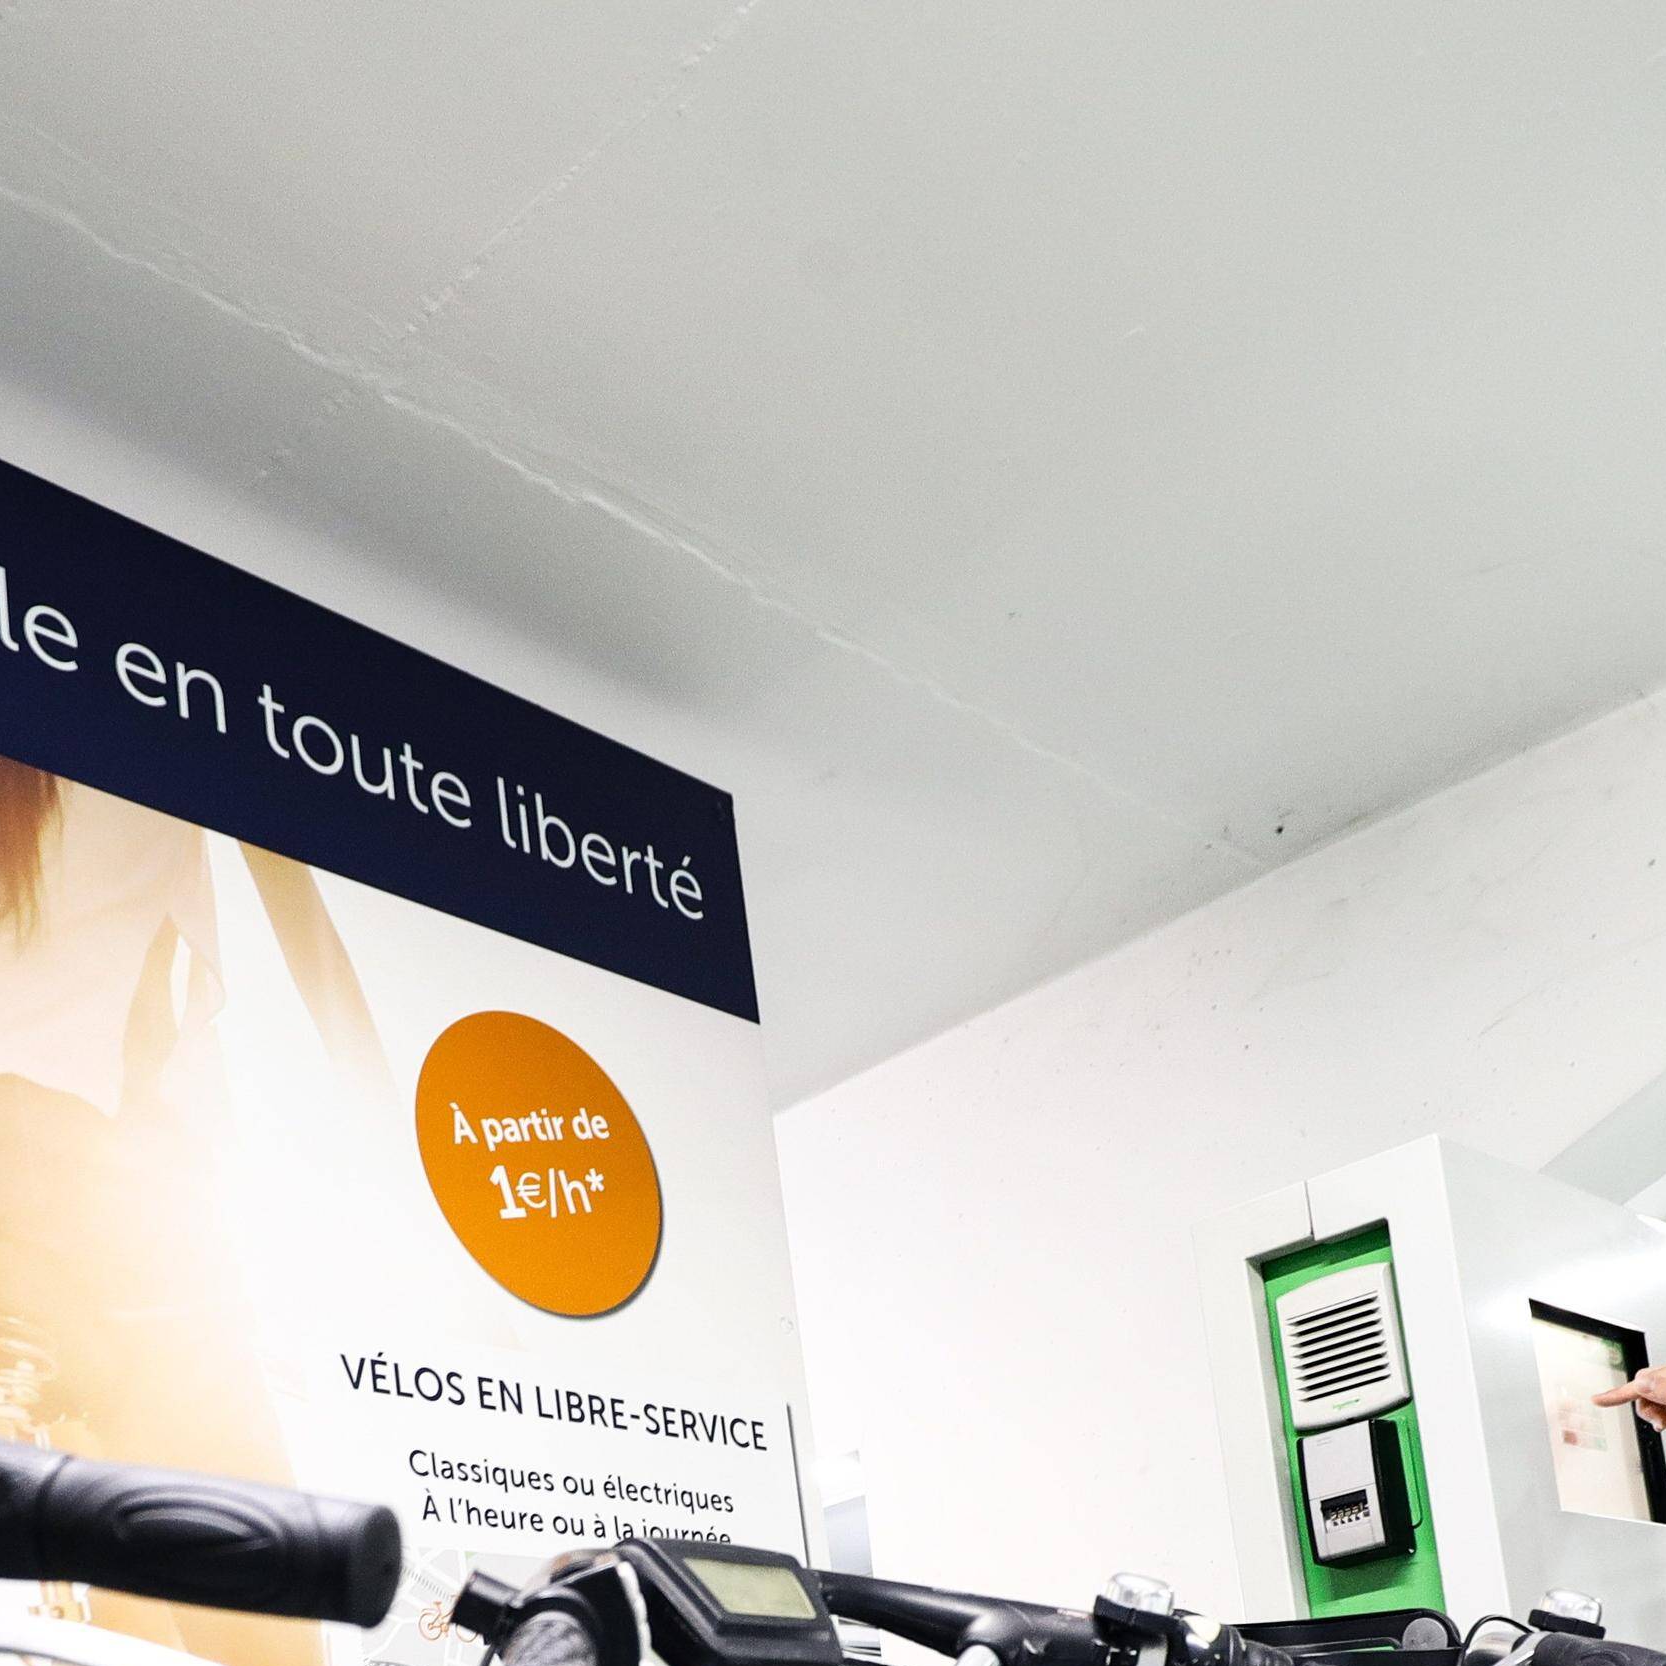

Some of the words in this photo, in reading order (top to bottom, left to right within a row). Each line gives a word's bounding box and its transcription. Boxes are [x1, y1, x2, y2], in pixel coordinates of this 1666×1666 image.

[114, 641, 228, 734] en
[257, 683, 473, 829] toute
[496, 776, 704, 921] liberté
[448, 1101, 479, 1145] À
[480, 1107, 564, 1152] partir
[571, 1107, 611, 1141] de
[340, 1351, 466, 1407] VÉLOS
[477, 1375, 524, 1416] EN
[535, 1385, 768, 1452] LIBRE-SERVICE
[408, 1449, 555, 1493] Classiques
[562, 1475, 595, 1497] ou
[603, 1474, 734, 1515] électriques
[421, 1487, 441, 1523] À
[449, 1496, 544, 1533] l'heure
[552, 1514, 585, 1537] ou
[593, 1512, 607, 1540] à
[614, 1514, 635, 1542] la
